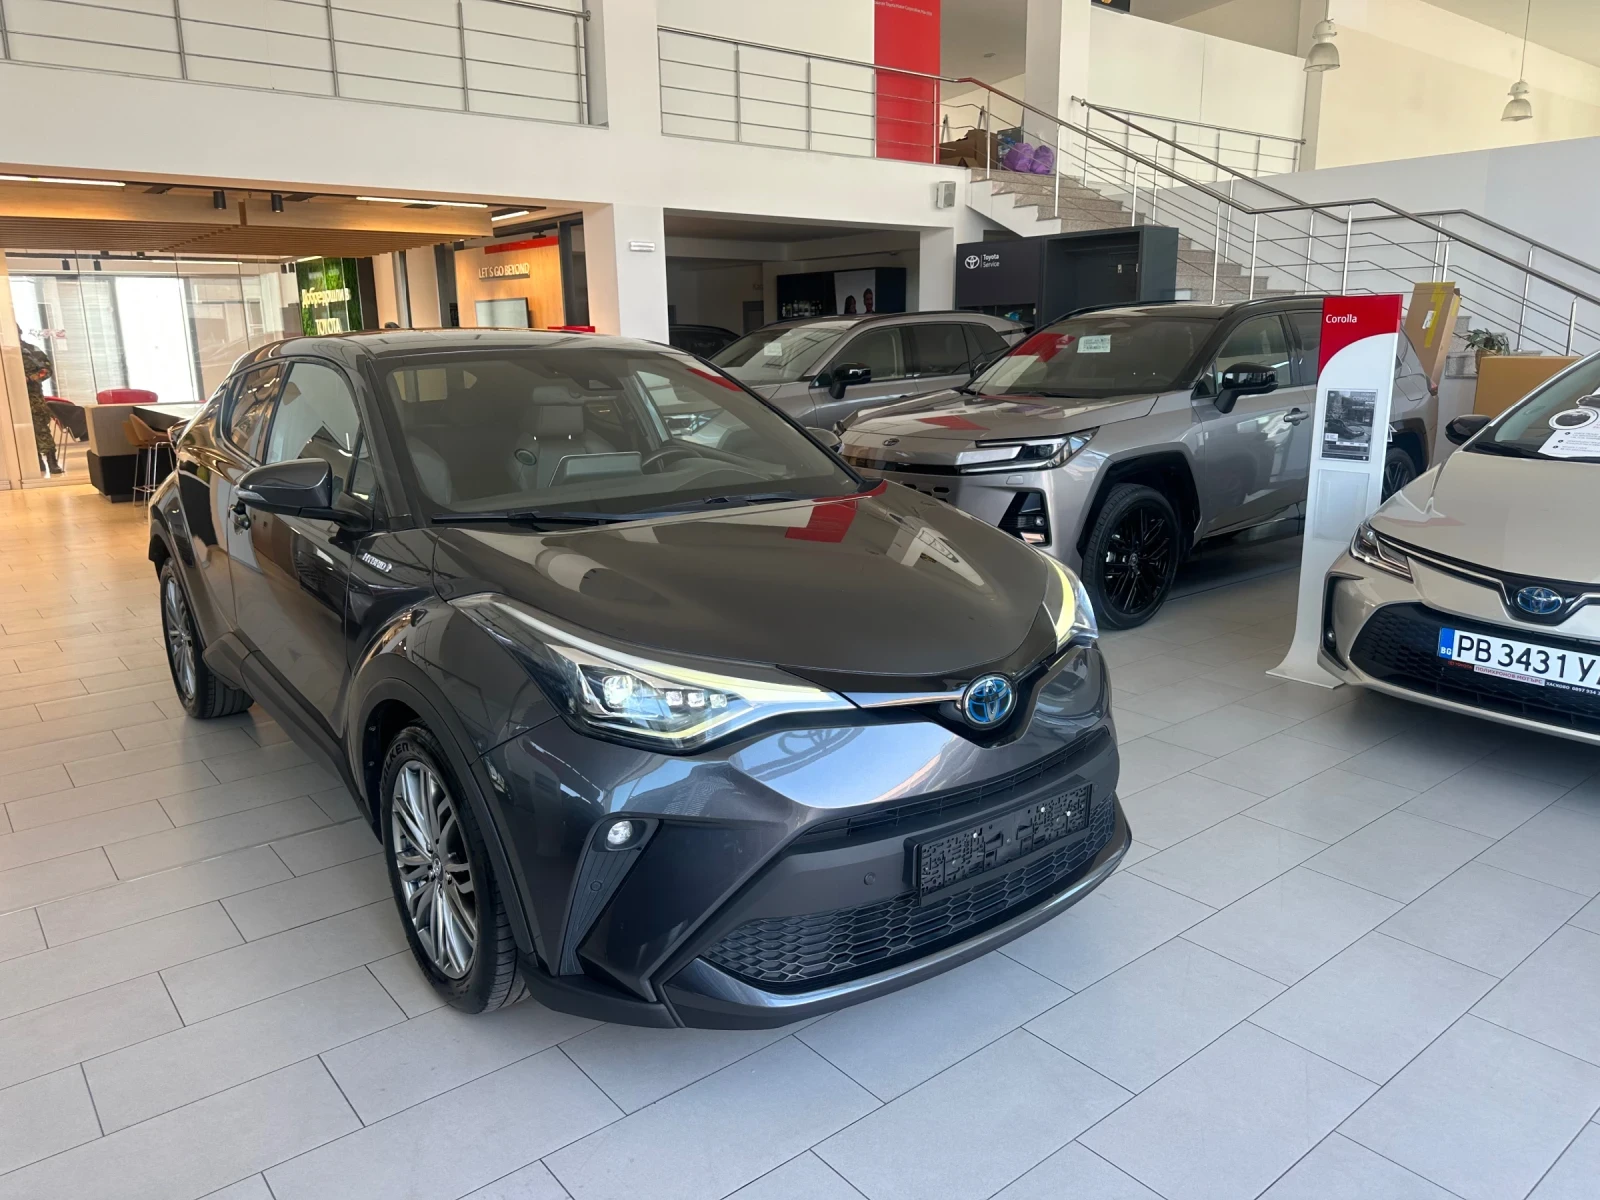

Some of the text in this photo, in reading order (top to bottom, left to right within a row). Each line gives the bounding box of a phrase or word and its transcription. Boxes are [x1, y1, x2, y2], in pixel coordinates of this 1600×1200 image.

[494, 265, 504, 276] GO
[504, 262, 530, 275] BEYOND
[314, 317, 343, 336] TOYOTA
[1325, 314, 1357, 323] Corolla
[1440, 646, 1452, 655] BG
[1497, 643, 1567, 678] 3431
[1475, 666, 1543, 684] ПОЛИХРОНОВ МОТЪРС
